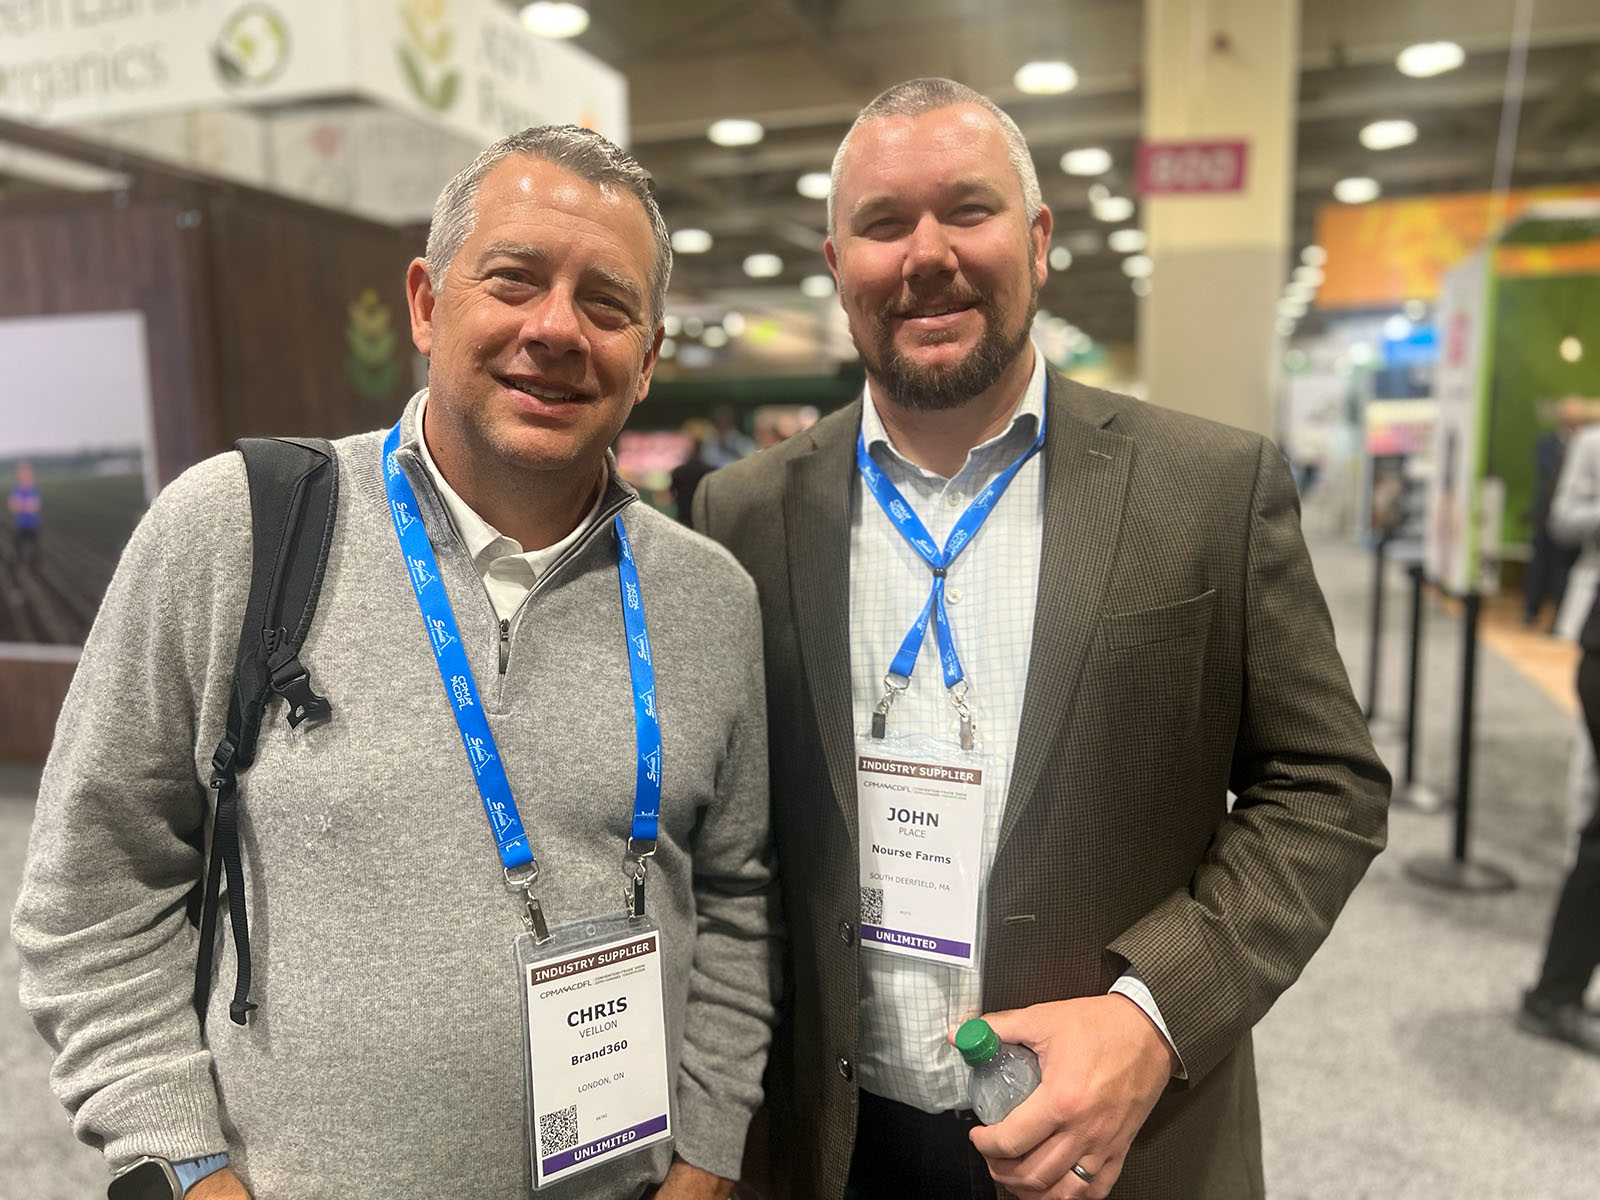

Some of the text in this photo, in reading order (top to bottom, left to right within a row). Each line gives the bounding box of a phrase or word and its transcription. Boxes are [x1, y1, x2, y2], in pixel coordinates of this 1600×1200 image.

[0, 42, 171, 115] rganics
[449, 678, 465, 710] ACDFL
[457, 674, 471, 704] CPMA
[862, 760, 974, 782] INDUSTRY SUPPLIER
[887, 807, 939, 827] JOHN
[899, 827, 926, 838] PLACE
[872, 844, 952, 865] Nourse Farms
[869, 872, 950, 892] SOUTH DEERFIELD, MA
[876, 930, 937, 950] UNLIMITED
[535, 956, 596, 982] INDUSTRY
[598, 942, 650, 965] SUPPLIER
[566, 997, 628, 1028] CHRIS
[578, 1020, 618, 1038] VEILLON
[571, 1039, 628, 1066] Brand360
[578, 1072, 625, 1093] LONDON, ON
[574, 1130, 636, 1161] UNLIMITED
